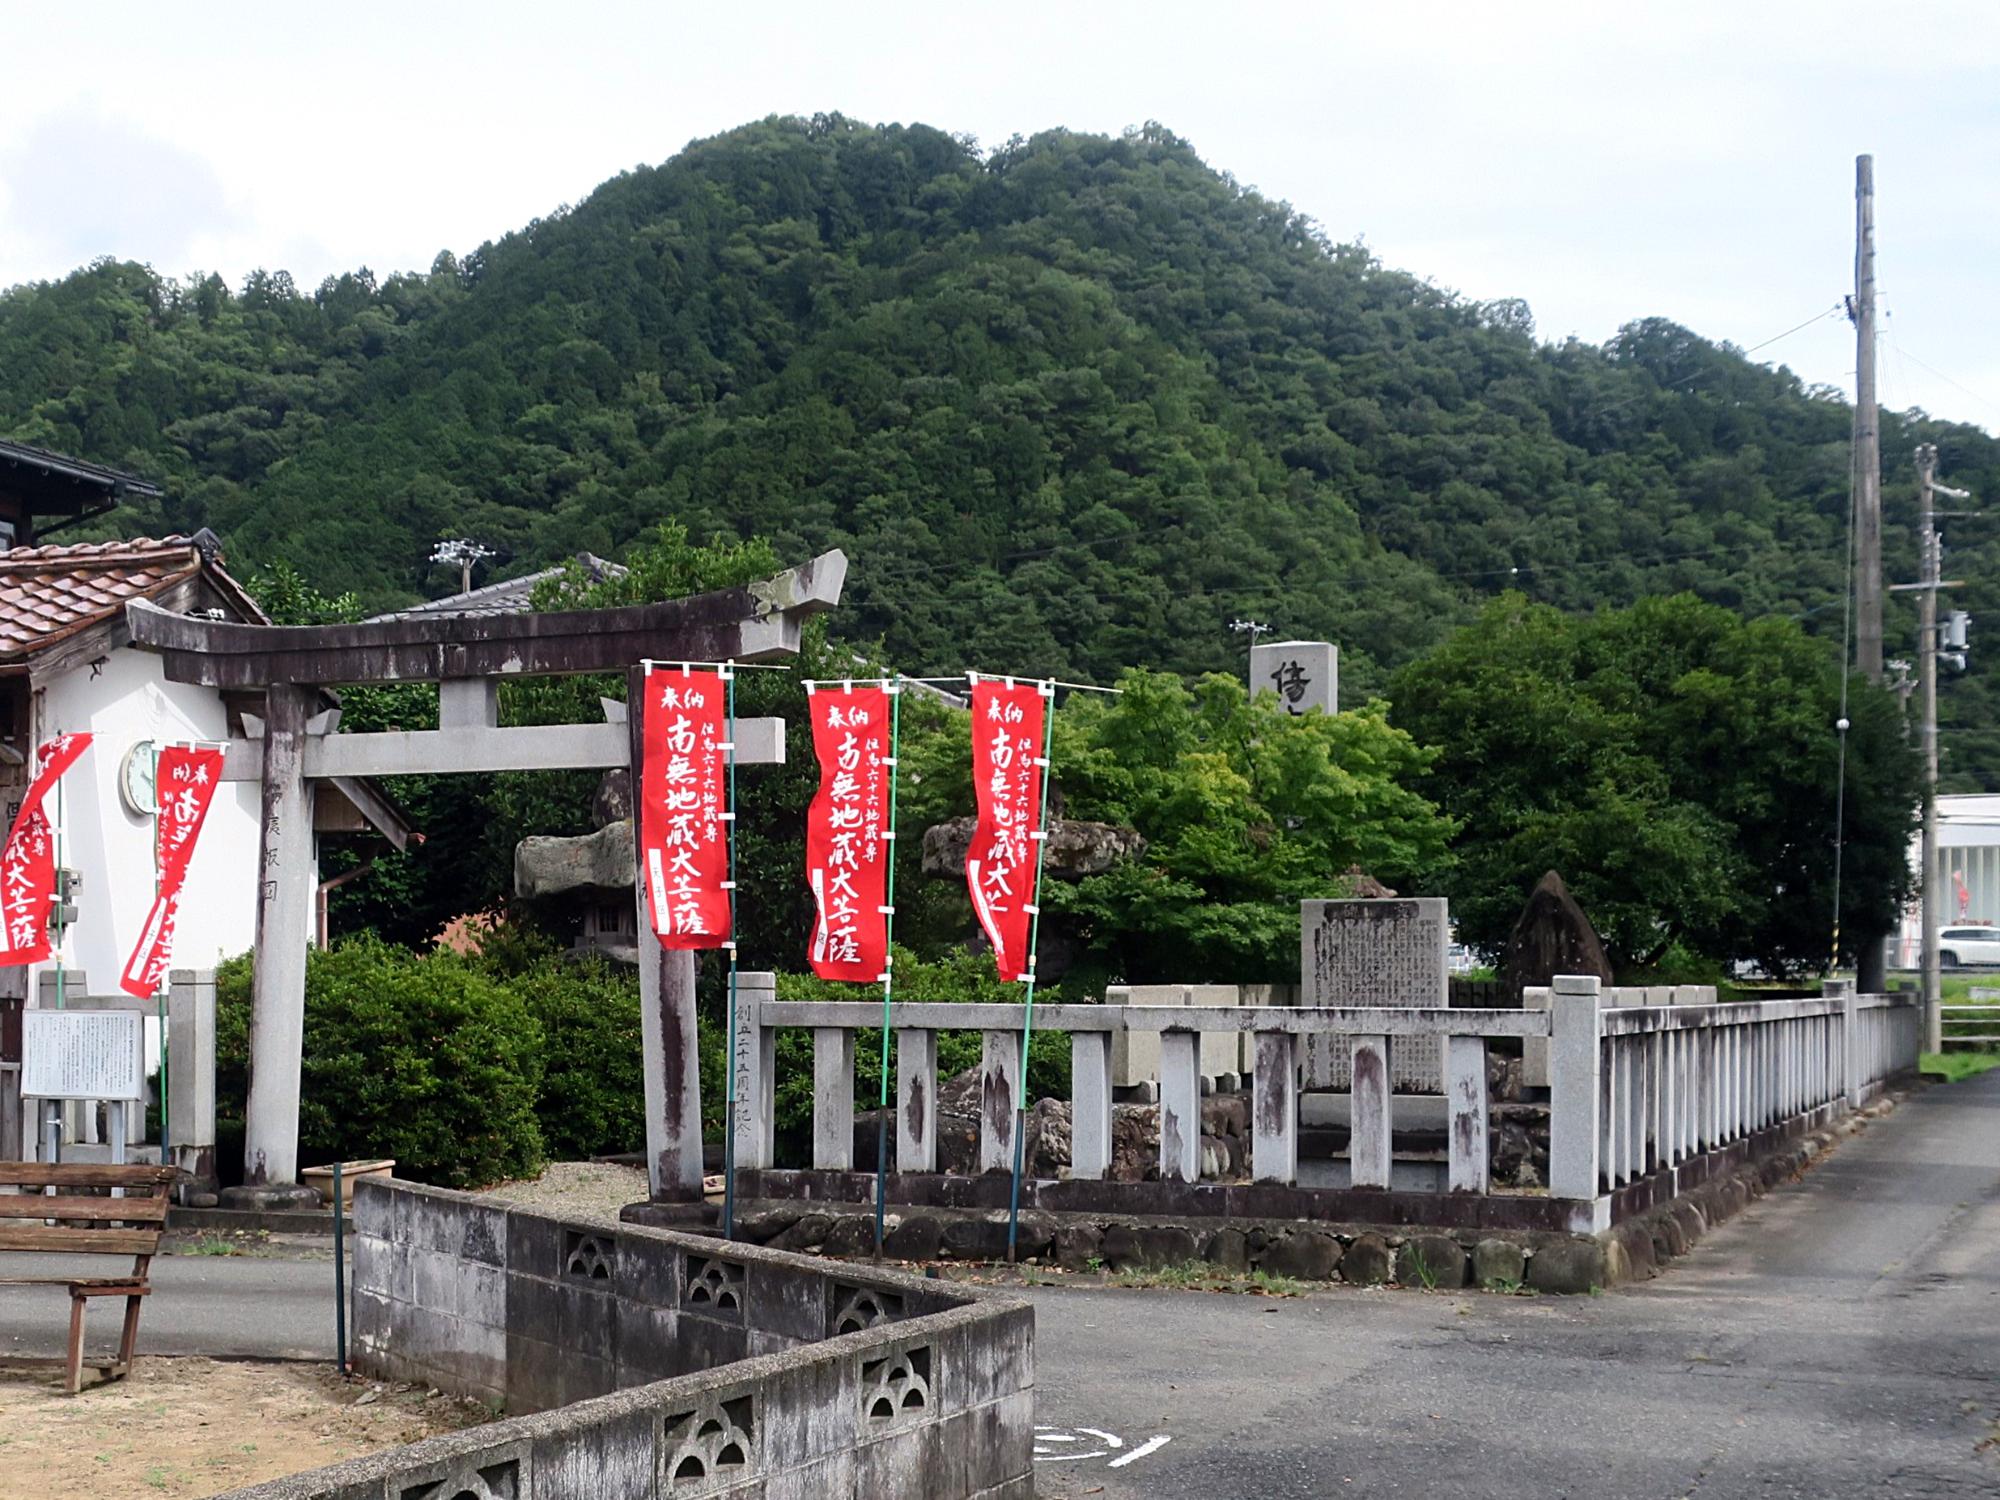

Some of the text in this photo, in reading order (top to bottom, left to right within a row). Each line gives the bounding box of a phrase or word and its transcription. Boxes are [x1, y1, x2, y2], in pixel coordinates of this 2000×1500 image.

[661, 686, 704, 709] 奉納
[827, 706, 869, 728] 奉納
[987, 697, 1023, 723] 奉納
[664, 715, 709, 935] 南無地蔵大菩薩
[828, 732, 863, 963] 南無地蔵大菩薩
[984, 727, 1016, 912] 南無地蔵大菩
[735, 1004, 752, 1138] 創立二十五周年記念
